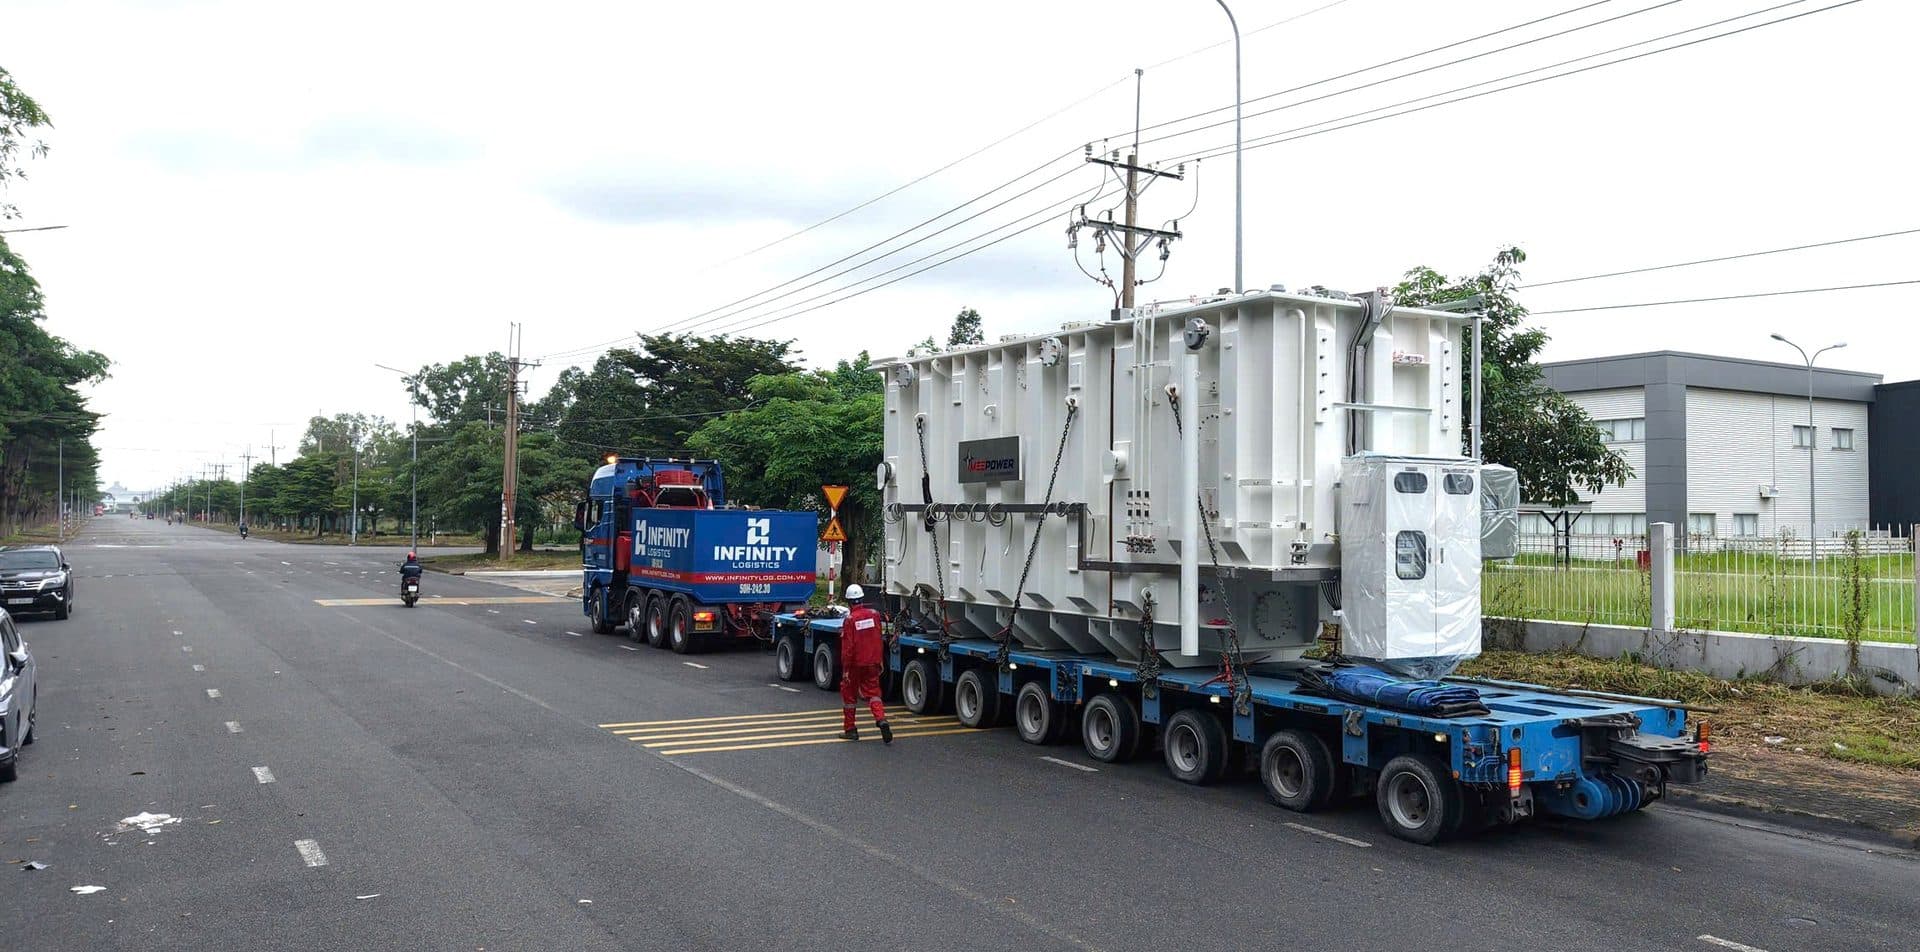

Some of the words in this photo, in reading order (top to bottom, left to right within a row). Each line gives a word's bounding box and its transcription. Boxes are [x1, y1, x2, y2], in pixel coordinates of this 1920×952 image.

[648, 527, 690, 548] INFINITY
[647, 548, 671, 558] LOGISTICS
[714, 546, 797, 561] INFINITY
